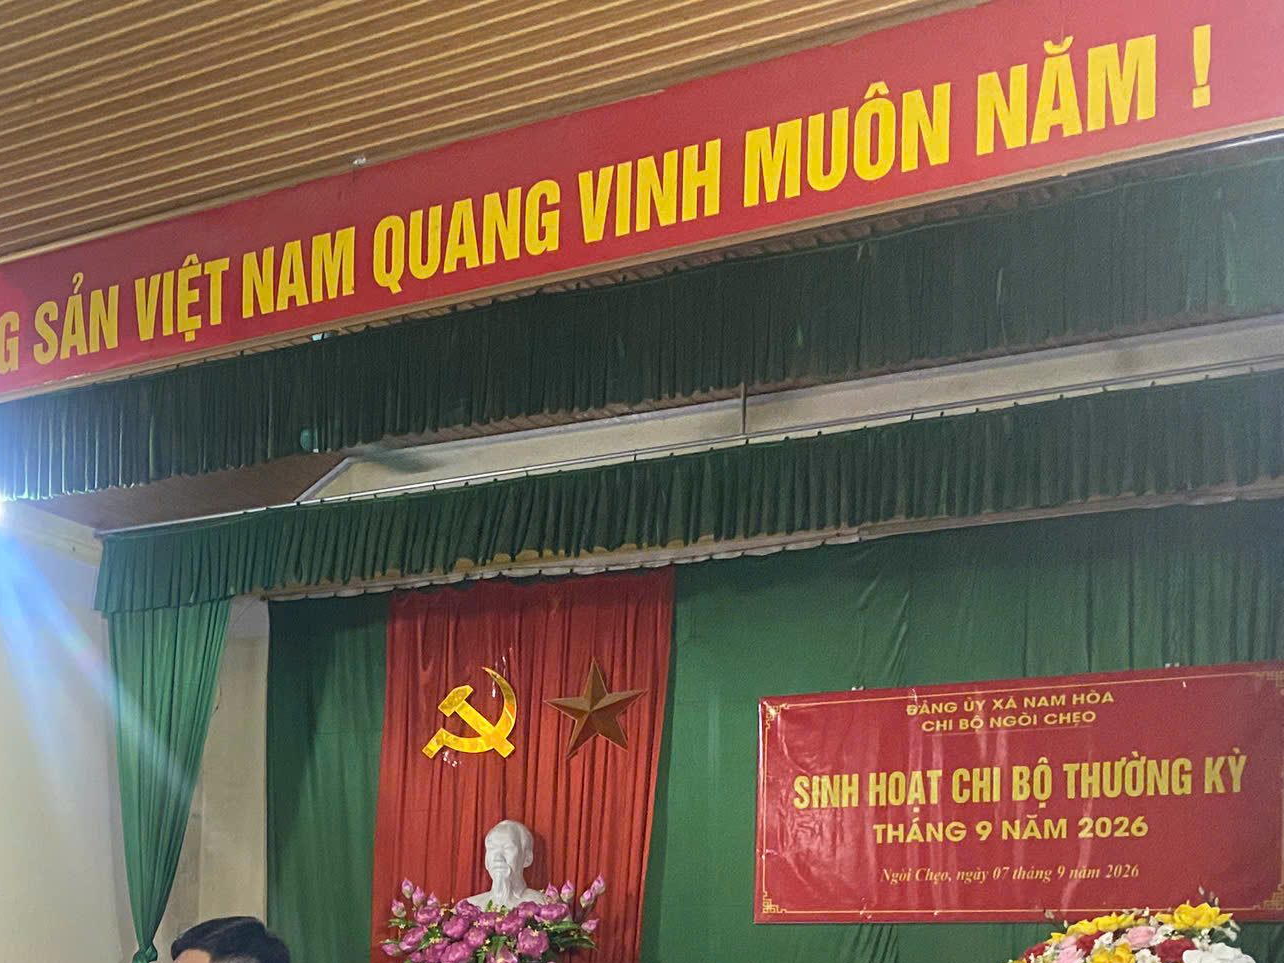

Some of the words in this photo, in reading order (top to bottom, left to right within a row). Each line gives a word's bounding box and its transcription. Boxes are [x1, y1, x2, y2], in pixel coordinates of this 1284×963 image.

[33, 272, 119, 365] SẢN
[134, 253, 230, 342] VIỆT
[242, 226, 355, 319] NAM
[372, 179, 561, 295] QUANG
[578, 138, 722, 243] VINH
[743, 81, 952, 208] MUÔN
[976, 34, 1157, 156] NĂM
[1191, 24, 1211, 109] !
[1023, 694, 1066, 708] NAM
[921, 719, 953, 732] CHI
[959, 714, 984, 733] BỘ
[989, 712, 1037, 728] NGÒI
[1043, 710, 1096, 727] CHẸO
[793, 773, 859, 809] SINH
[868, 769, 942, 813] HOẠT
[952, 767, 1001, 804] CHI
[1012, 756, 1052, 808] BỘ
[1062, 751, 1193, 799] THƯỜNG
[1204, 747, 1247, 794] KỲ
[873, 817, 967, 844] THÁNG
[975, 820, 993, 841] 9
[1001, 814, 1068, 840] NĂM
[1077, 815, 1149, 838] 2026
[956, 867, 988, 885] ngày
[992, 866, 1010, 880] 07
[1012, 865, 1052, 883] tháng
[1057, 865, 1066, 879] 9
[1069, 865, 1101, 879] năm
[1105, 863, 1139, 879] 2026
